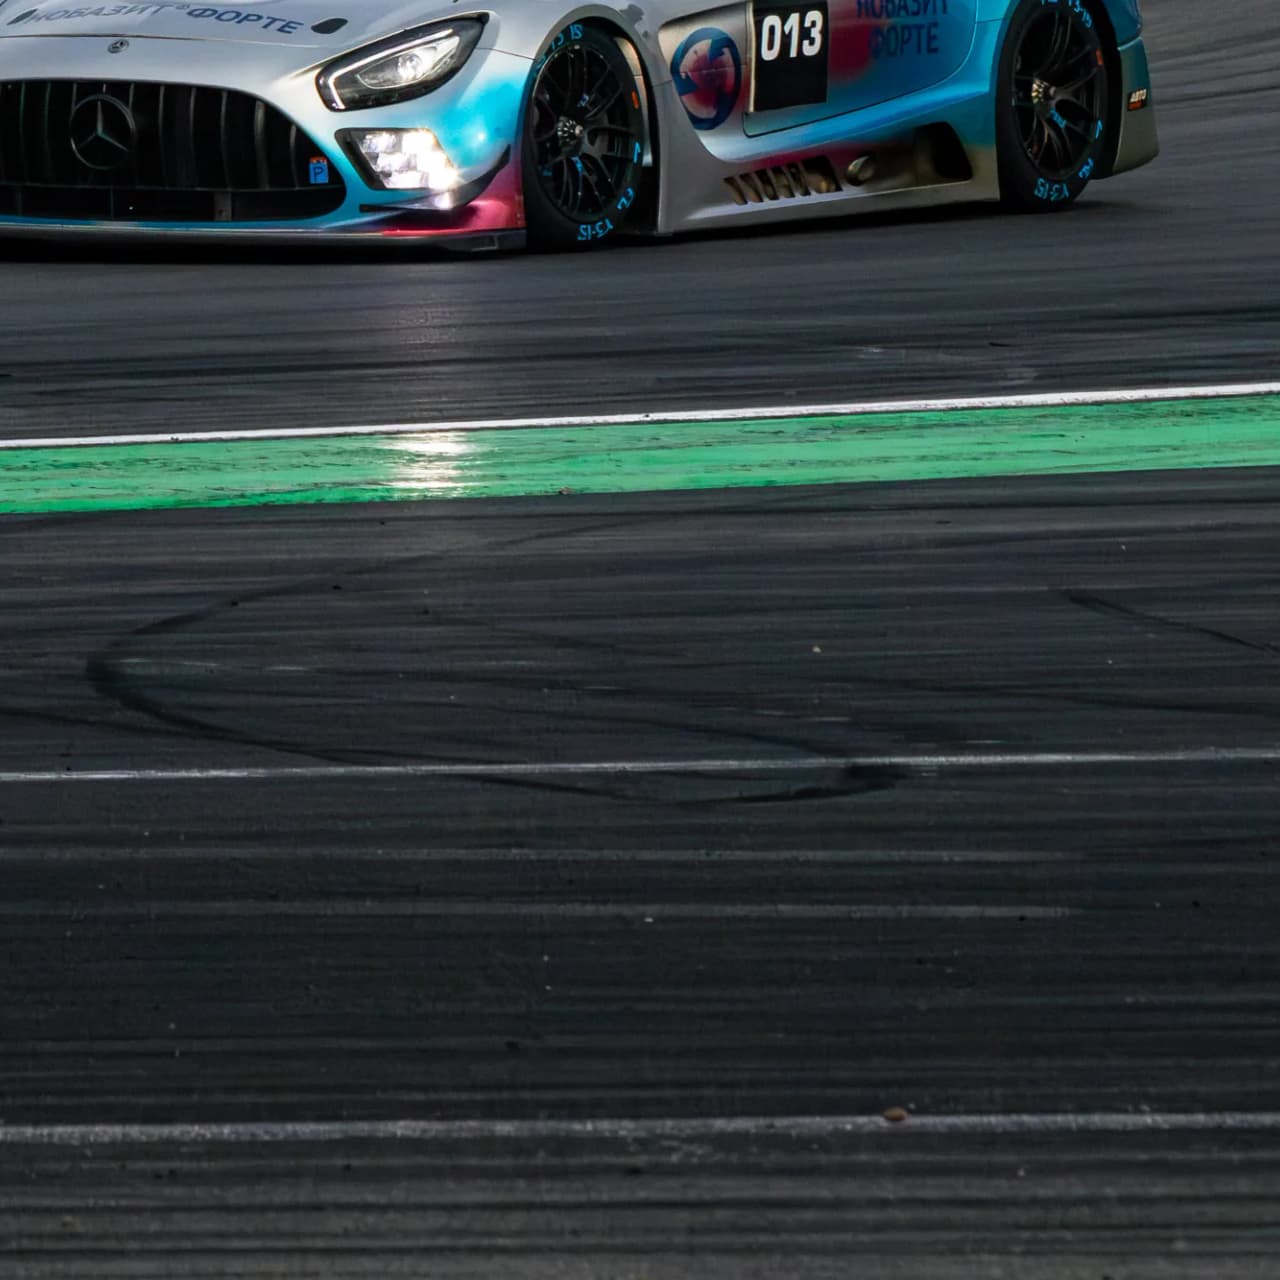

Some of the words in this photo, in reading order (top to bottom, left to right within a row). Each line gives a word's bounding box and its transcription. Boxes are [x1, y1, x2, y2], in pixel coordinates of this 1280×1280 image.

[187, 7, 304, 34] ФОРТЕ
[760, 10, 823, 61] 013
[869, 21, 940, 59] ФОРТЕ
[313, 166, 324, 184] P
